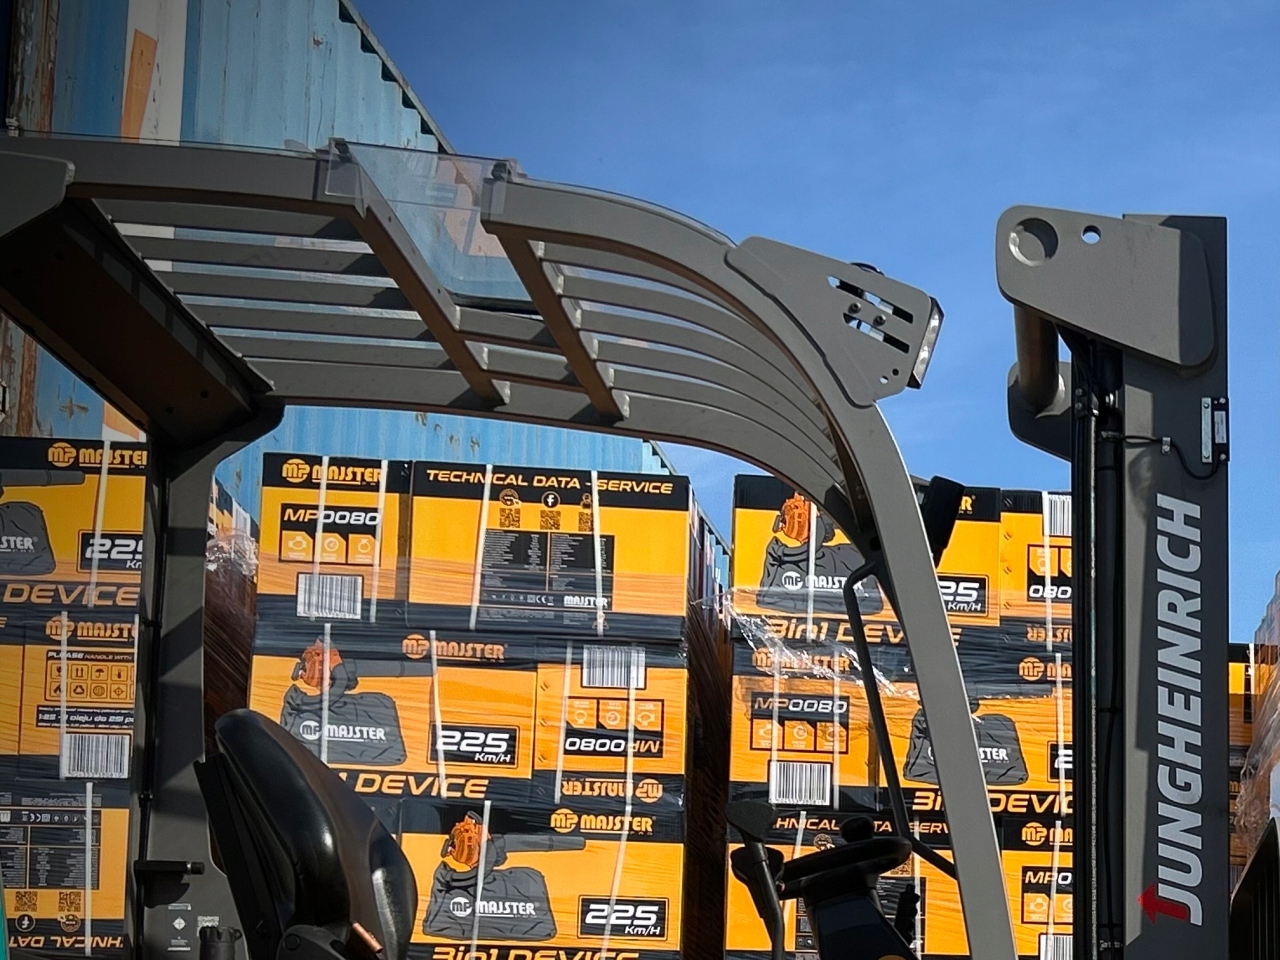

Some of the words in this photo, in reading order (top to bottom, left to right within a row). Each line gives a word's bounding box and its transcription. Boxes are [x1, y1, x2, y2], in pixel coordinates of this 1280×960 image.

[532, 476, 580, 489] DATA
[596, 480, 673, 494] SERVICE
[3, 584, 140, 606] DEVICE
[1152, 493, 1203, 926] JUNGHEINRICH
[437, 731, 509, 752] 225
[475, 753, 510, 763] Km/H
[580, 815, 653, 830] MAJSTER
[475, 901, 535, 914] MAJSTER
[585, 904, 658, 925] 225
[625, 926, 660, 935] Km/H
